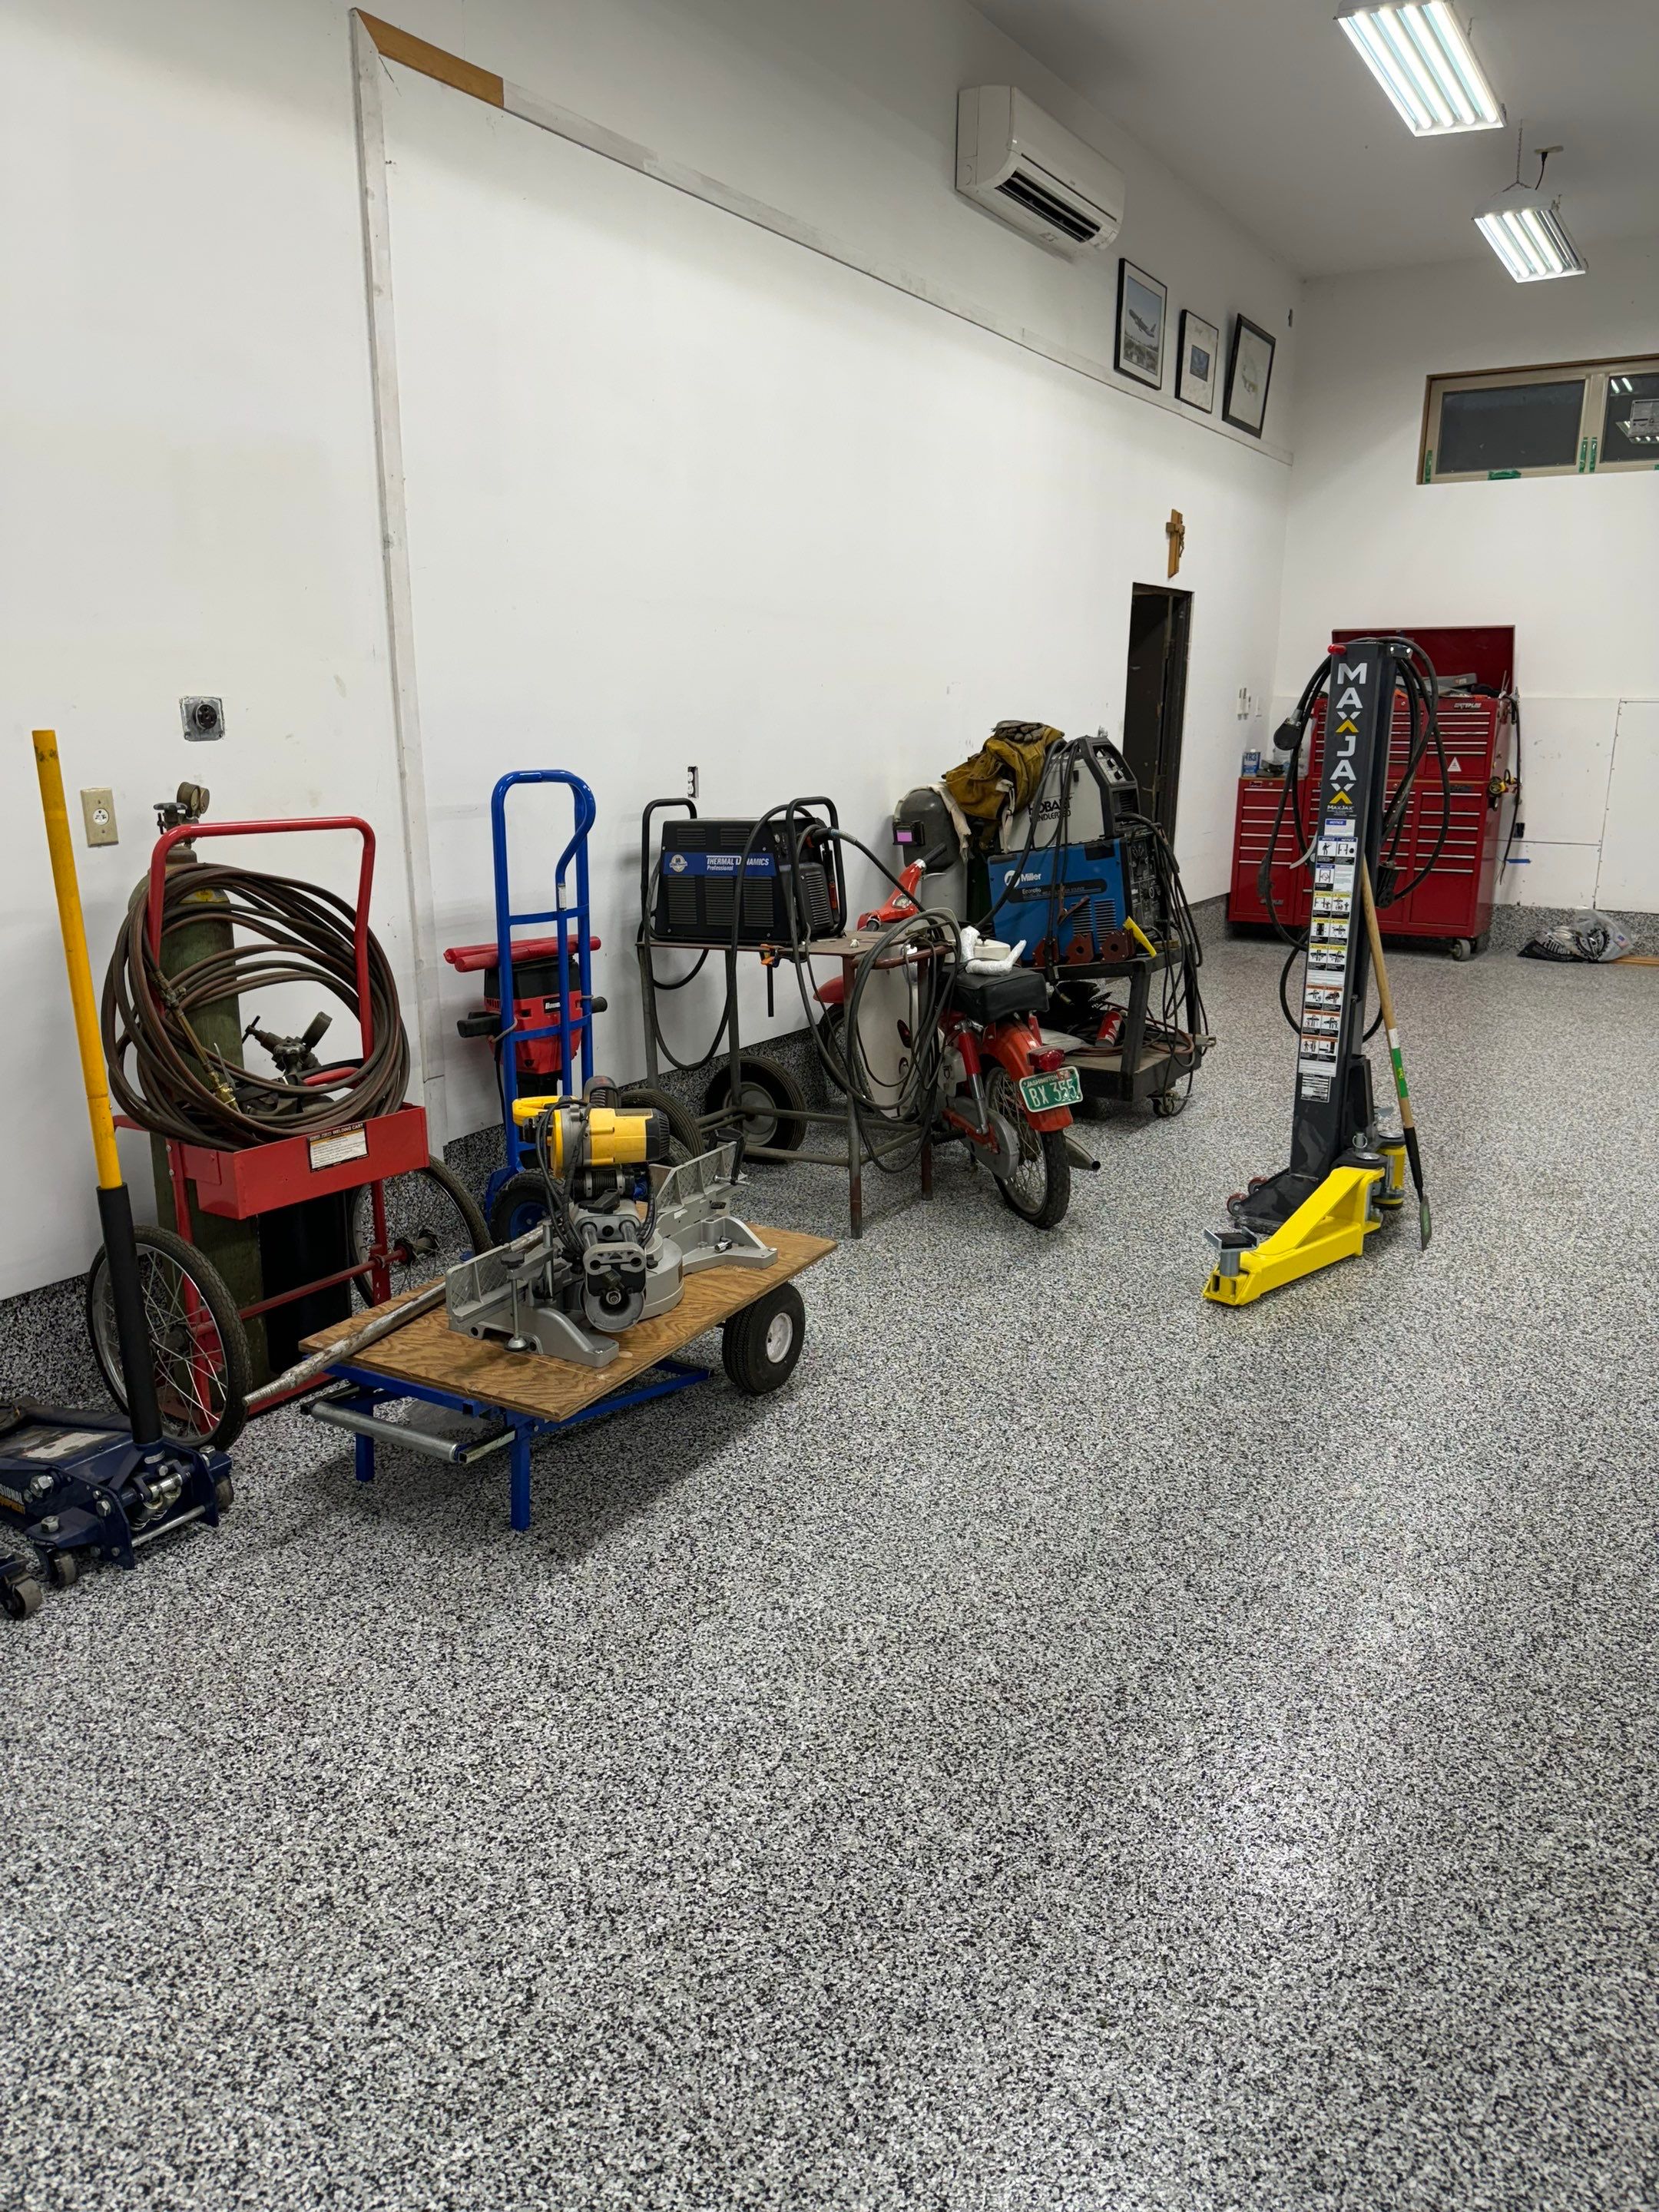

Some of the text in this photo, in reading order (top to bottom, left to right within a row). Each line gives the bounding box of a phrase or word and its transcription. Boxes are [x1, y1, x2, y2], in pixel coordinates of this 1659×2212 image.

[1330, 663, 1368, 804] MAXJAX
[1028, 796, 1073, 815] OBA
[1029, 811, 1058, 823] NDLER
[707, 856, 770, 866] THERMAL DAMICS
[1021, 873, 1041, 882] Miller
[1028, 1078, 1077, 1107] BX 355
[333, 1126, 352, 1134] WELDING
